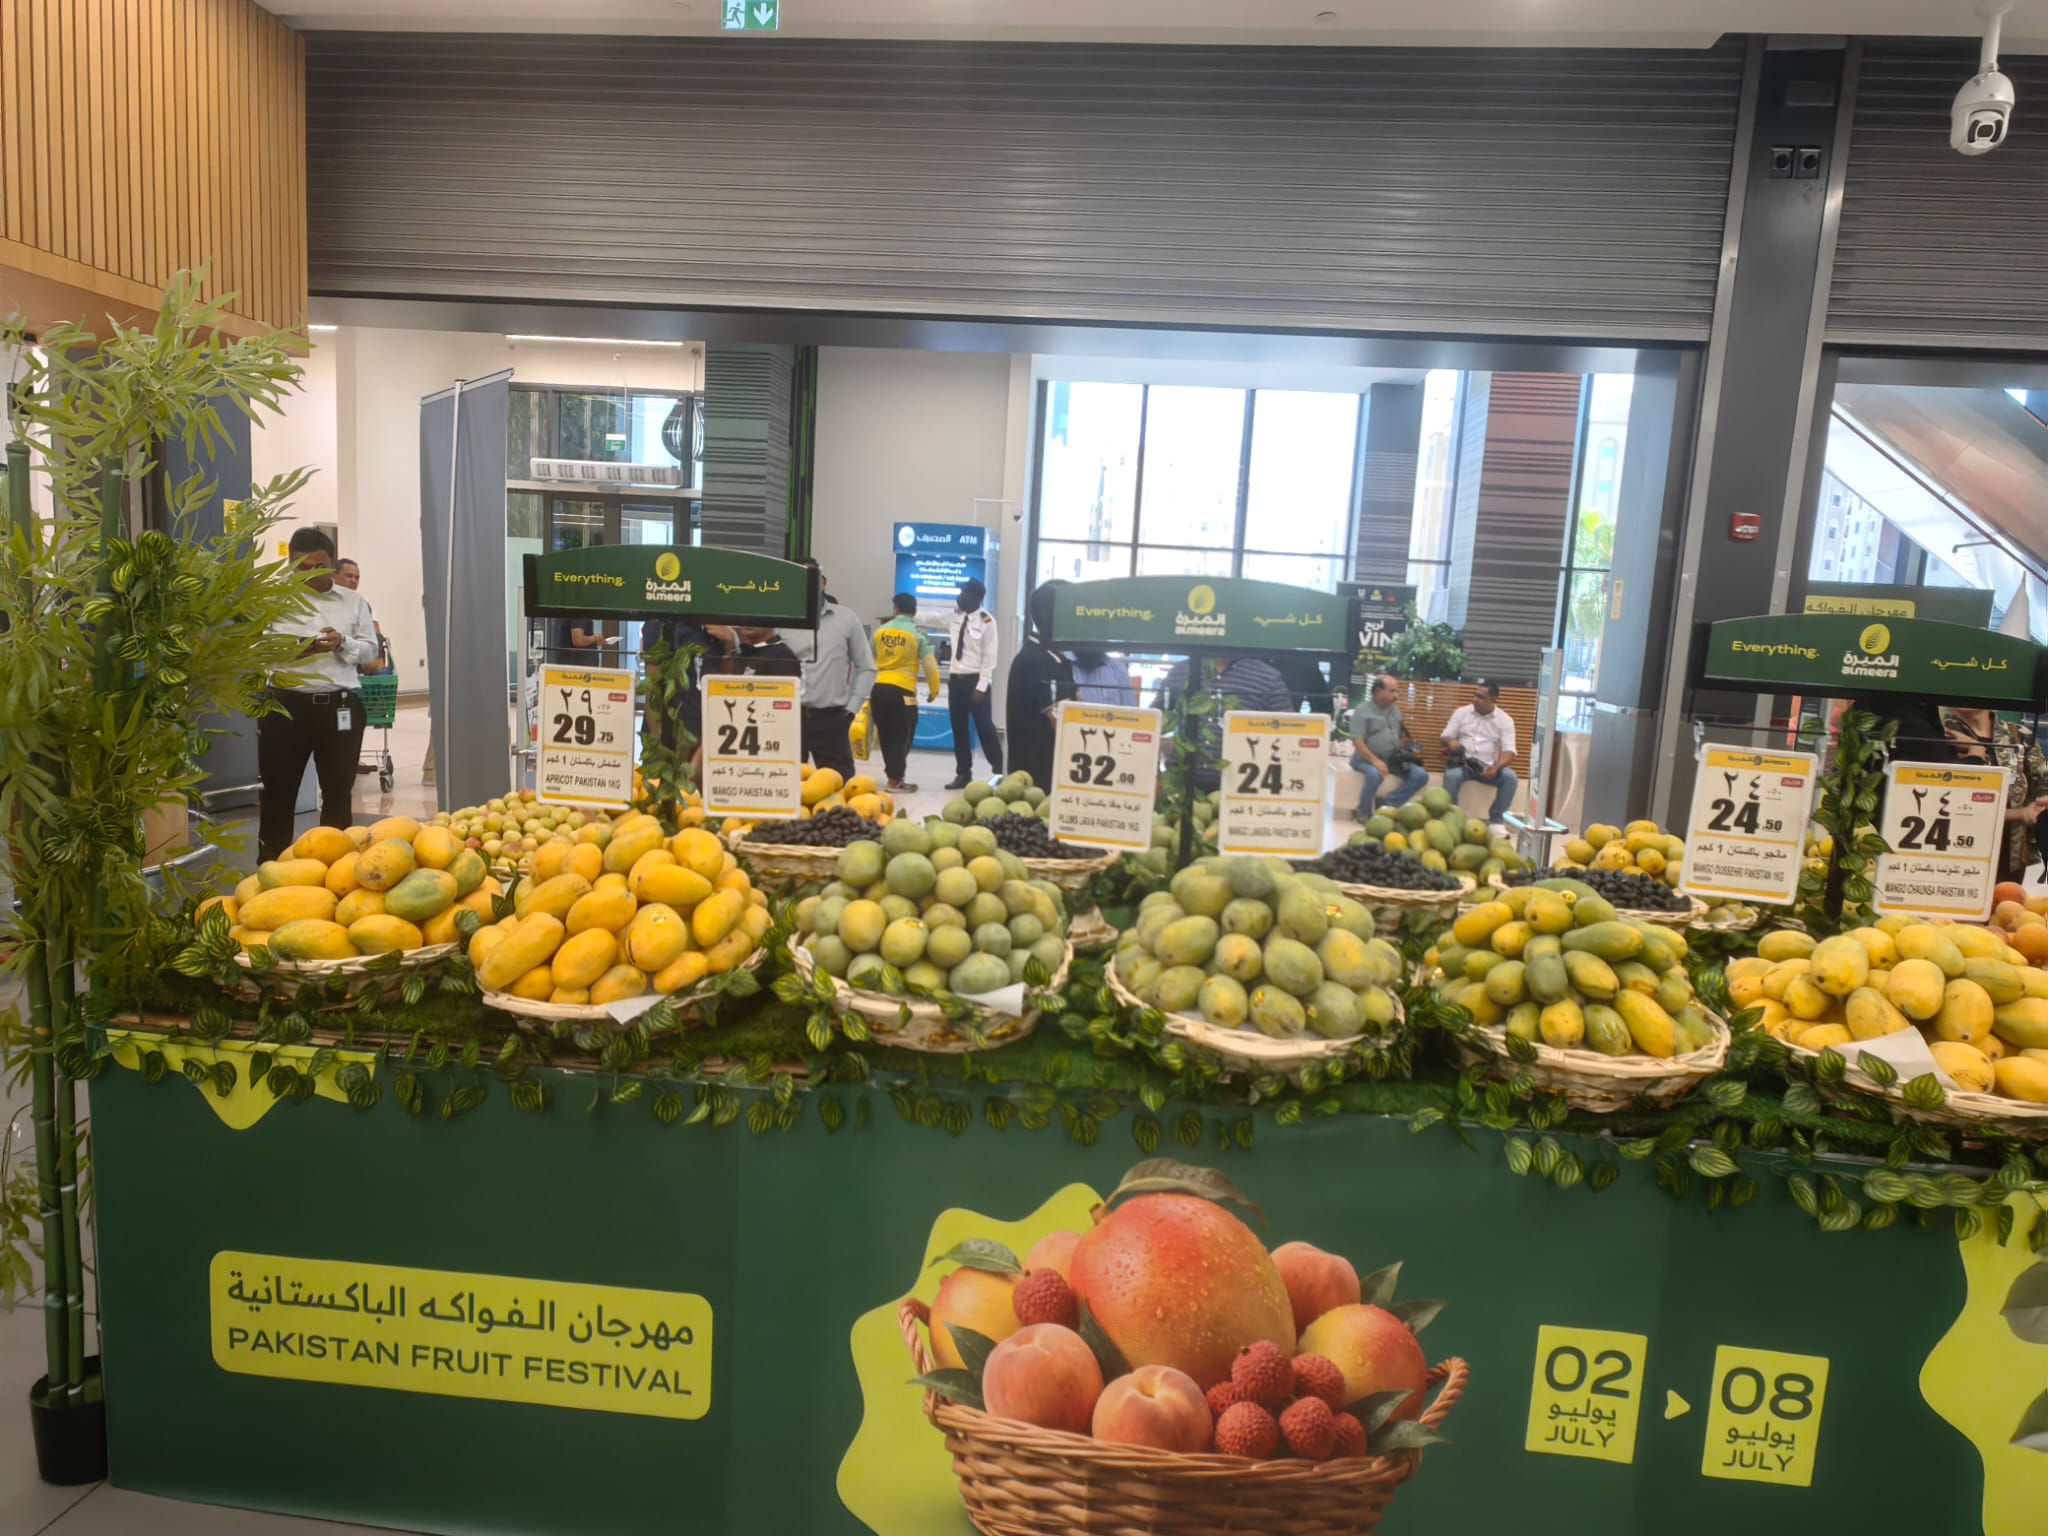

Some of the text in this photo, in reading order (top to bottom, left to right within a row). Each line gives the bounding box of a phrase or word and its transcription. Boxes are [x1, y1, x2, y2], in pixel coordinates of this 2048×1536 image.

[959, 535, 978, 545] ATM
[645, 577, 692, 593] الميرة
[645, 592, 692, 603] almeera
[1842, 650, 1900, 668] الميرة
[1981, 658, 2008, 671] كل
[1841, 666, 1898, 679] almeera
[545, 774, 575, 786] APRICOT
[574, 776, 607, 789] PAKISTAN
[607, 780, 621, 790] 1KG
[711, 786, 790, 799] MANGO PAKISTAN 1KG
[1884, 882, 1907, 895] MANGO
[1936, 886, 1966, 899] PAKISTAN
[1965, 888, 1980, 900] 1KG
[227, 1270, 694, 1351] مهرجان الفواكه الباكستانية
[228, 1327, 693, 1396] PAKISTAN FRUIT FESTIVAL
[1544, 1345, 1633, 1399] 02
[1720, 1366, 1815, 1421] 08
[1547, 1398, 1617, 1427] يوليو
[1544, 1425, 1616, 1448] JULY
[1725, 1421, 1796, 1450] يوليو
[1721, 1449, 1795, 1473] JULY
